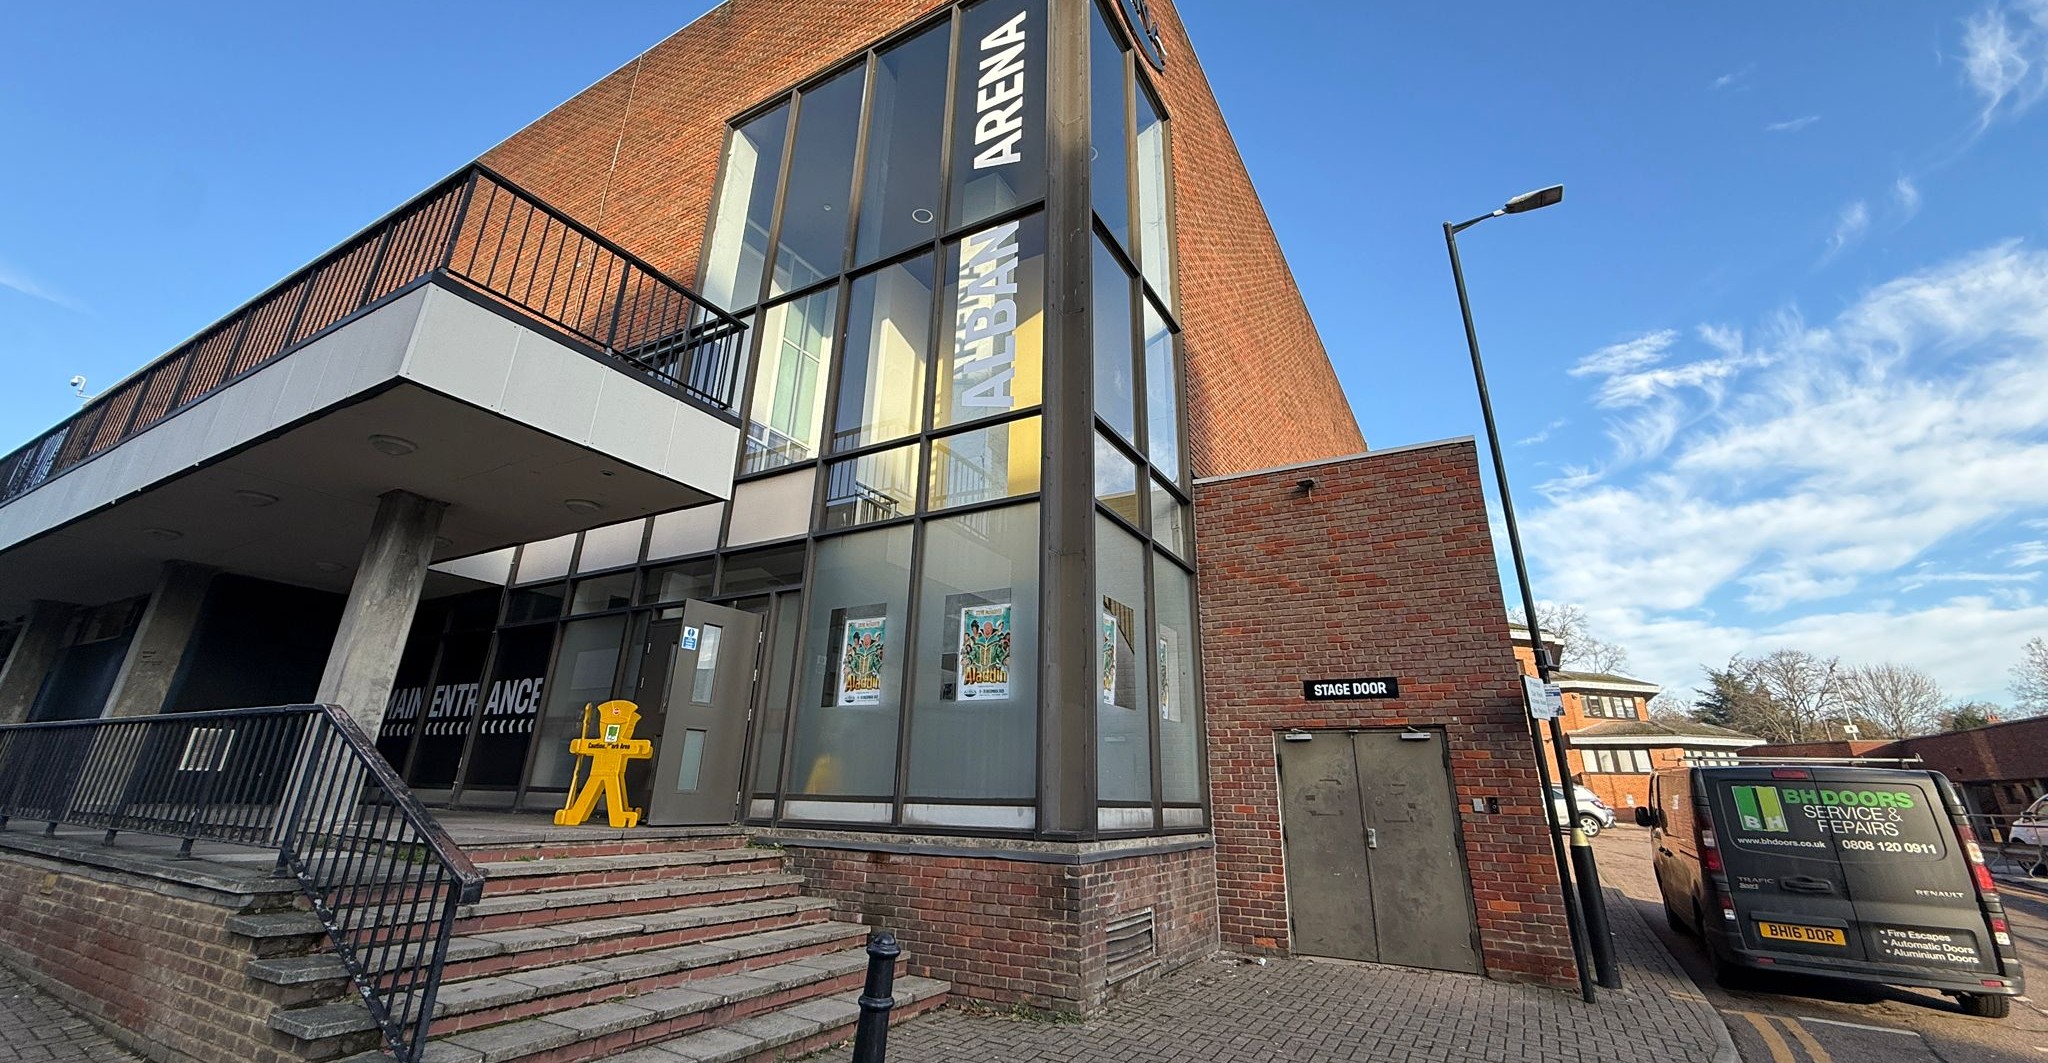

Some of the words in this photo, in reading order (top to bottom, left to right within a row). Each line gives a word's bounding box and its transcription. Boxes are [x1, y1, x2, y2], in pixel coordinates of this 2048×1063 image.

[974, 10, 1027, 170] ARENA
[962, 220, 1019, 407] ALBAN
[963, 667, 1008, 685] Aladdin
[1314, 683, 1350, 696] STAGE
[1352, 682, 1387, 695] DOOR
[428, 677, 544, 718] ENTRANCE
[1803, 805, 1884, 821] SERVICE
[1888, 807, 1904, 822] &
[1737, 837, 1826, 849] www.bhdoors.co.uk
[1842, 839, 1875, 851] 0808
[1879, 842, 1901, 852] 120
[1905, 843, 1937, 855] 0911
[1737, 876, 1775, 884] TRAFIC
[1915, 889, 1965, 898] RENAULT
[1769, 924, 1801, 939] BH16
[1807, 928, 1836, 942] DOR
[1888, 929, 1906, 939] Fire
[1907, 931, 1951, 942] Escapes
[1891, 939, 1941, 951] Automatic
[1942, 943, 1975, 955] Doors
[1894, 949, 1946, 961] Aluminium
[1948, 953, 1979, 964] Doors
